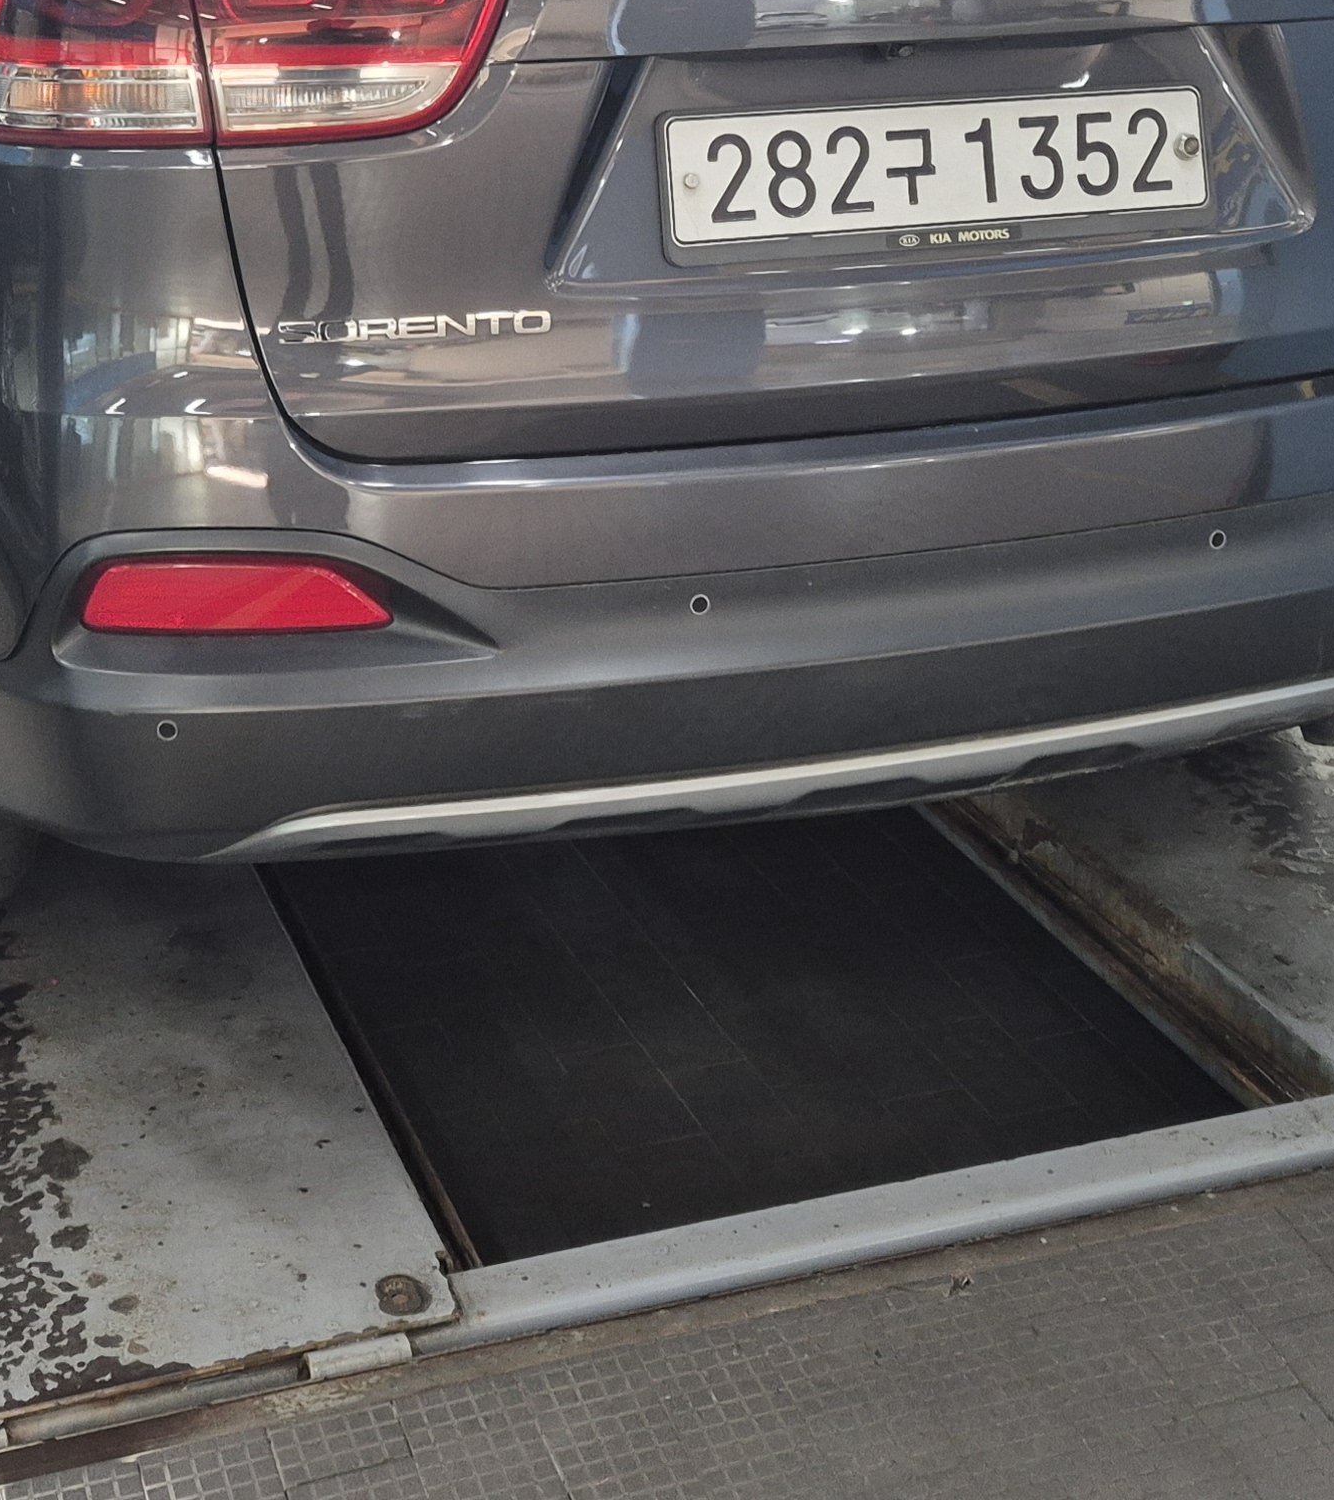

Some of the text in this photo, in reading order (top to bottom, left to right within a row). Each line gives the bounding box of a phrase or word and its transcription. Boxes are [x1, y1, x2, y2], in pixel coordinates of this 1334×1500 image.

[706, 107, 1174, 224] 282구 1352
[929, 228, 1011, 244] KIA MOTORS
[278, 309, 552, 345] SORENTO
